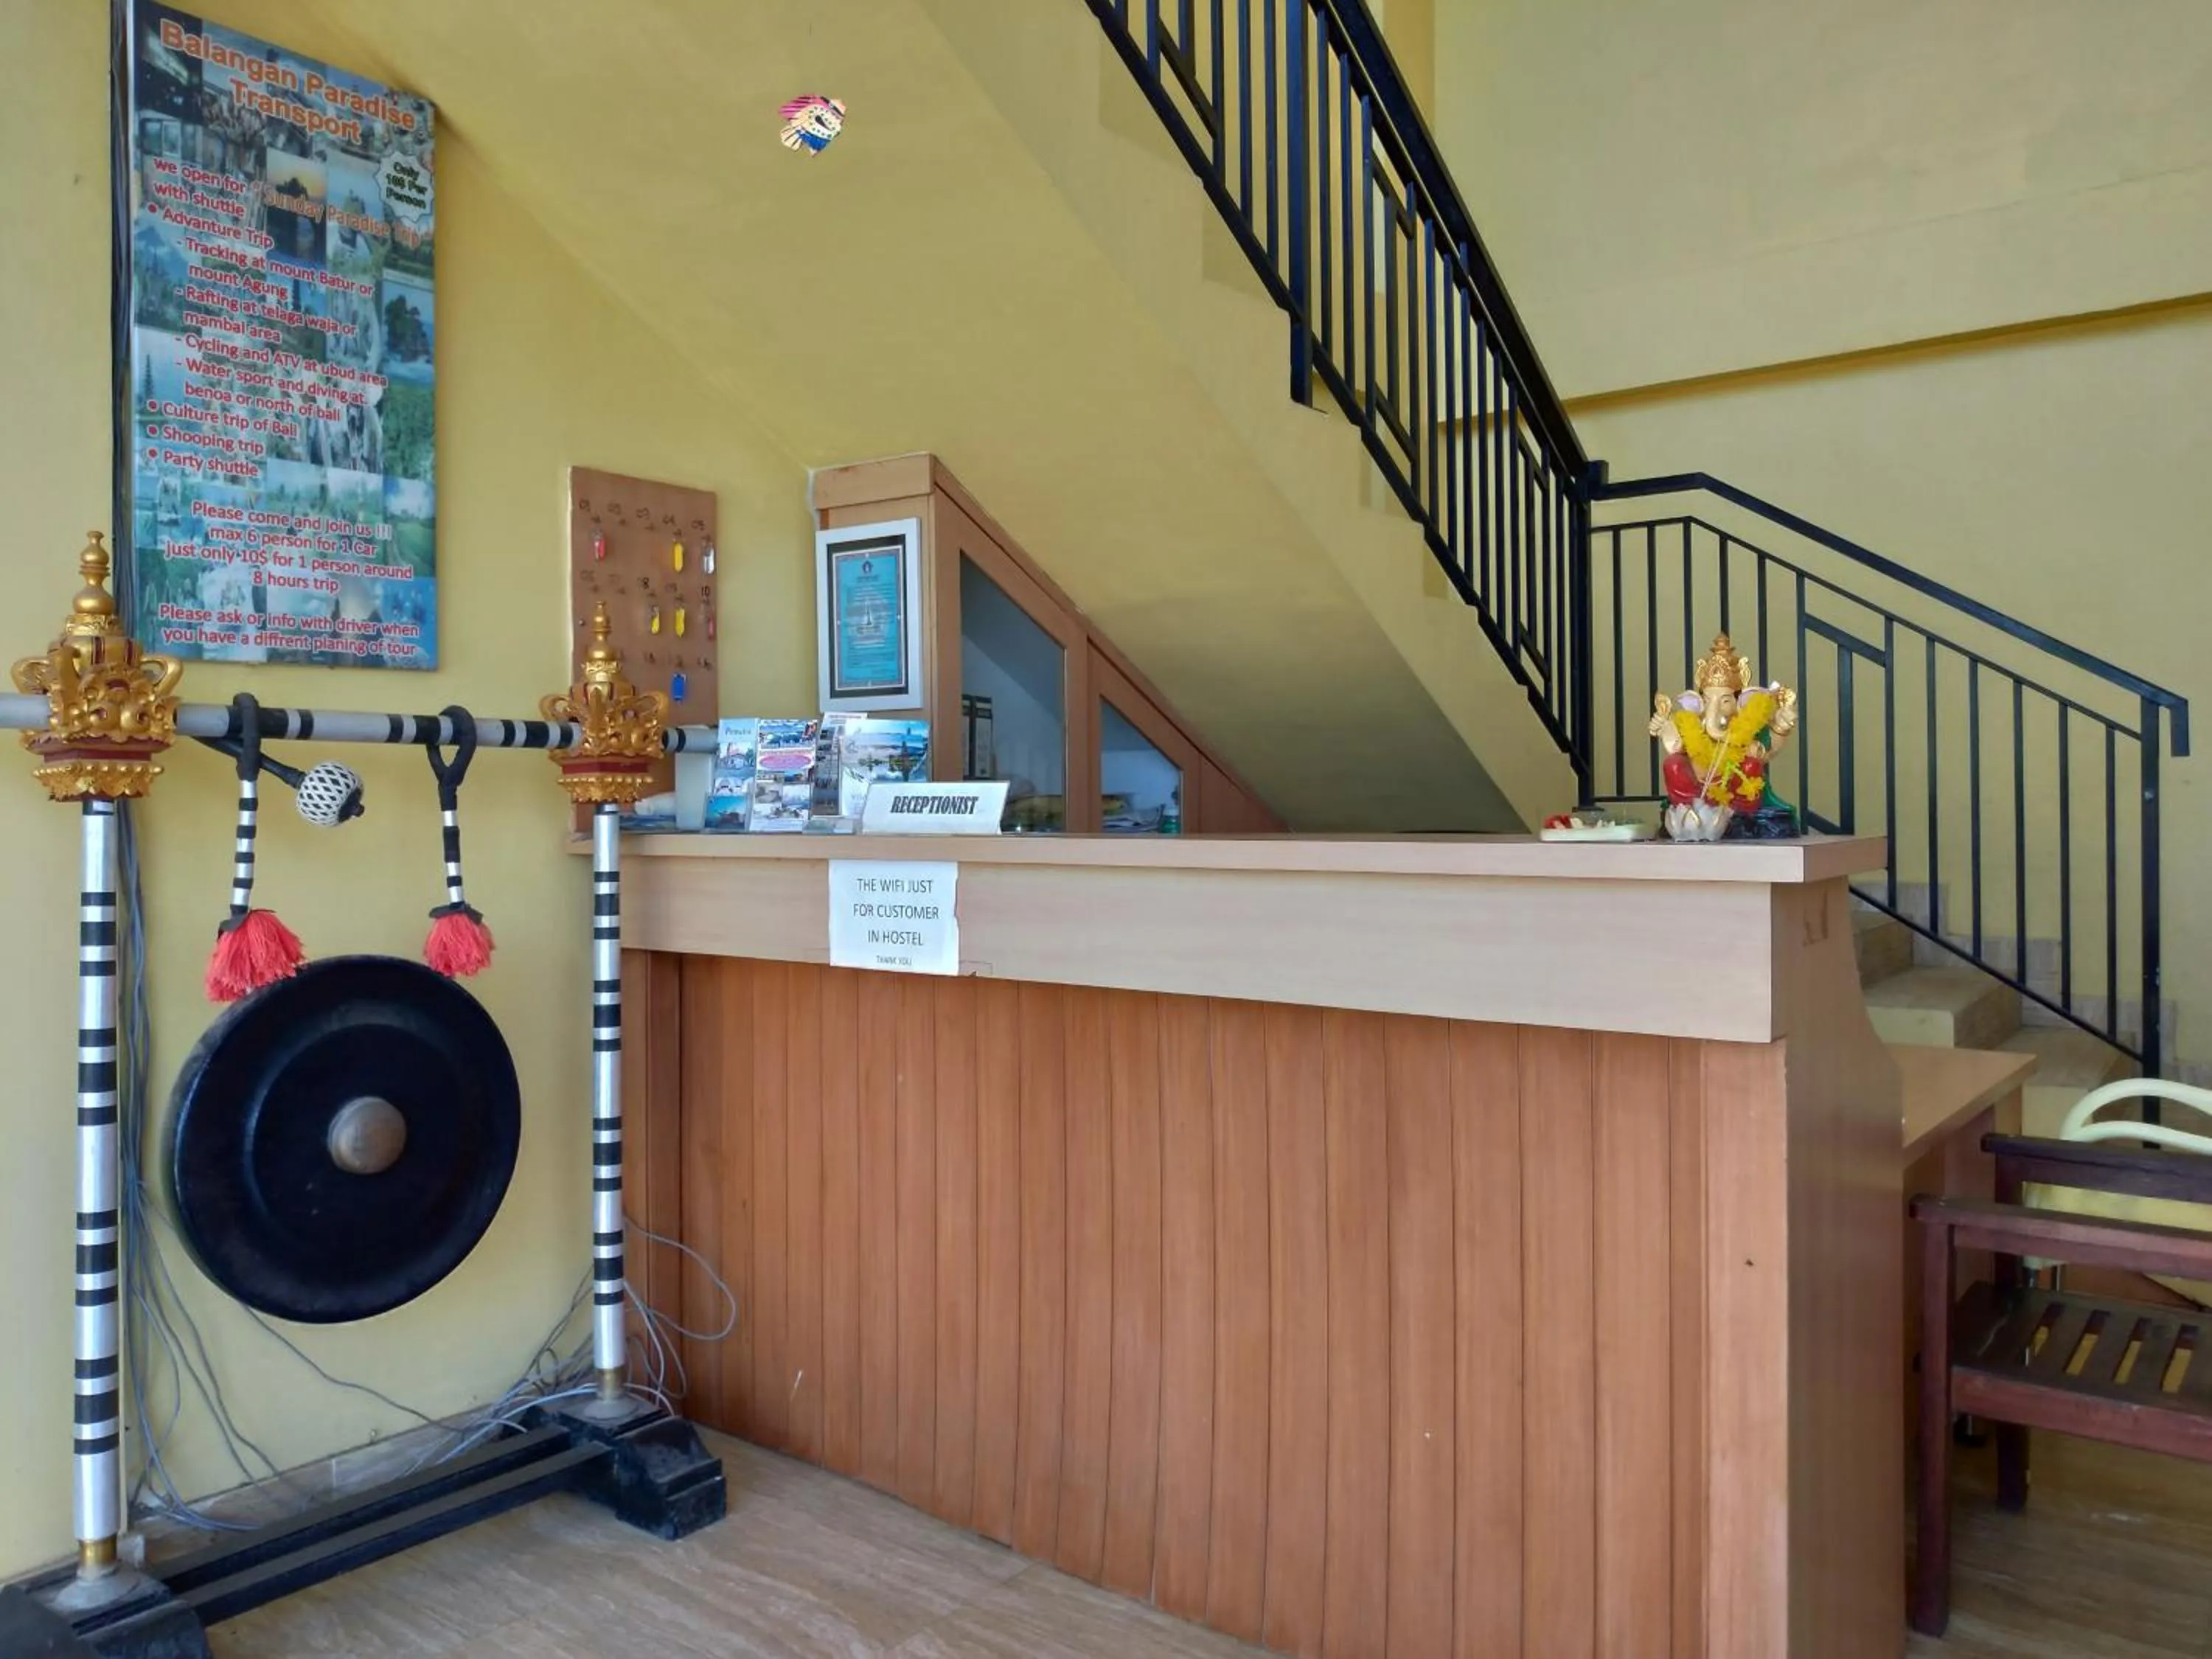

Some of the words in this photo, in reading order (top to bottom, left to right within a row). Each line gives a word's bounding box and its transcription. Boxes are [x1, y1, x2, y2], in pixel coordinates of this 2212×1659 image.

[161, 19, 297, 89] Balangan
[305, 72, 417, 130] Paradise
[230, 78, 361, 144] Transport
[154, 158, 177, 173] we
[181, 164, 220, 187] open
[223, 173, 246, 193] for
[153, 182, 189, 201] with
[191, 190, 246, 218] shuttle
[163, 207, 242, 239] Advanture
[246, 229, 274, 250] Trip
[184, 237, 247, 268] Tracking
[251, 255, 265, 269] at
[269, 261, 316, 282] mount
[319, 271, 356, 290] Batur
[358, 282, 373, 295] or
[189, 265, 240, 285] mount
[243, 274, 289, 300] Agung
[184, 312, 246, 334] mambal
[250, 325, 281, 343] area
[186, 286, 238, 312] Rafting
[243, 298, 257, 313] at
[260, 302, 303, 325] telaga
[306, 313, 340, 333] waja
[342, 322, 356, 336] or
[185, 334, 238, 360] Cycling
[243, 344, 269, 363] and
[274, 351, 301, 368] ATV
[304, 357, 318, 372] at
[321, 360, 355, 381] ubud
[358, 371, 387, 387] area
[185, 357, 231, 378] Water
[236, 369, 275, 392] sport
[279, 375, 304, 394] and
[307, 381, 346, 404] diving
[185, 381, 232, 403] benoa
[236, 392, 252, 404] or
[257, 394, 294, 413] north
[298, 403, 316, 418] of
[316, 404, 340, 421] bali
[163, 402, 220, 422] Culture
[223, 412, 248, 431] trip
[253, 417, 268, 431] of
[272, 418, 298, 438] Bali
[163, 426, 234, 452] Shooping
[238, 437, 264, 456] trip
[164, 451, 204, 471] Party
[207, 459, 260, 477] shuttle
[192, 501, 243, 520] Please
[248, 512, 290, 526] come
[294, 514, 321, 529] and
[324, 516, 352, 534] join
[356, 524, 372, 537] us
[209, 525, 242, 541] max
[247, 529, 257, 543] 6
[261, 530, 313, 552] person
[316, 536, 337, 551] for
[341, 538, 350, 554] 1
[352, 542, 377, 556] Car
[165, 541, 197, 558] just
[200, 547, 235, 563] only
[239, 549, 268, 566] 10$
[272, 553, 295, 566] for
[298, 554, 306, 568] 1
[311, 557, 359, 577] person
[364, 564, 412, 579] around
[253, 571, 262, 585] 8
[268, 571, 309, 588] hours
[313, 576, 338, 592] trip
[160, 605, 212, 622] Please
[216, 609, 242, 624] ask
[246, 613, 264, 625] or
[267, 611, 297, 627] info
[300, 616, 333, 631] with
[336, 618, 378, 633] driver
[381, 622, 420, 636] when
[163, 628, 193, 646] you
[198, 630, 236, 644] have
[240, 634, 249, 646] a
[254, 632, 310, 648] diffrent
[313, 636, 366, 655] planing
[369, 639, 385, 654] of
[386, 640, 416, 655] tour
[890, 796, 979, 815] RECEPTIONIST
[857, 879, 876, 891] THE
[880, 879, 904, 892] WIFI
[908, 880, 933, 893] JUST
[853, 904, 873, 917] FOR
[877, 905, 939, 919] CUSTOMER
[868, 931, 879, 942] IN
[883, 931, 923, 946] HOSTEL
[877, 956, 897, 964] THANK
[899, 957, 912, 965] YOU
